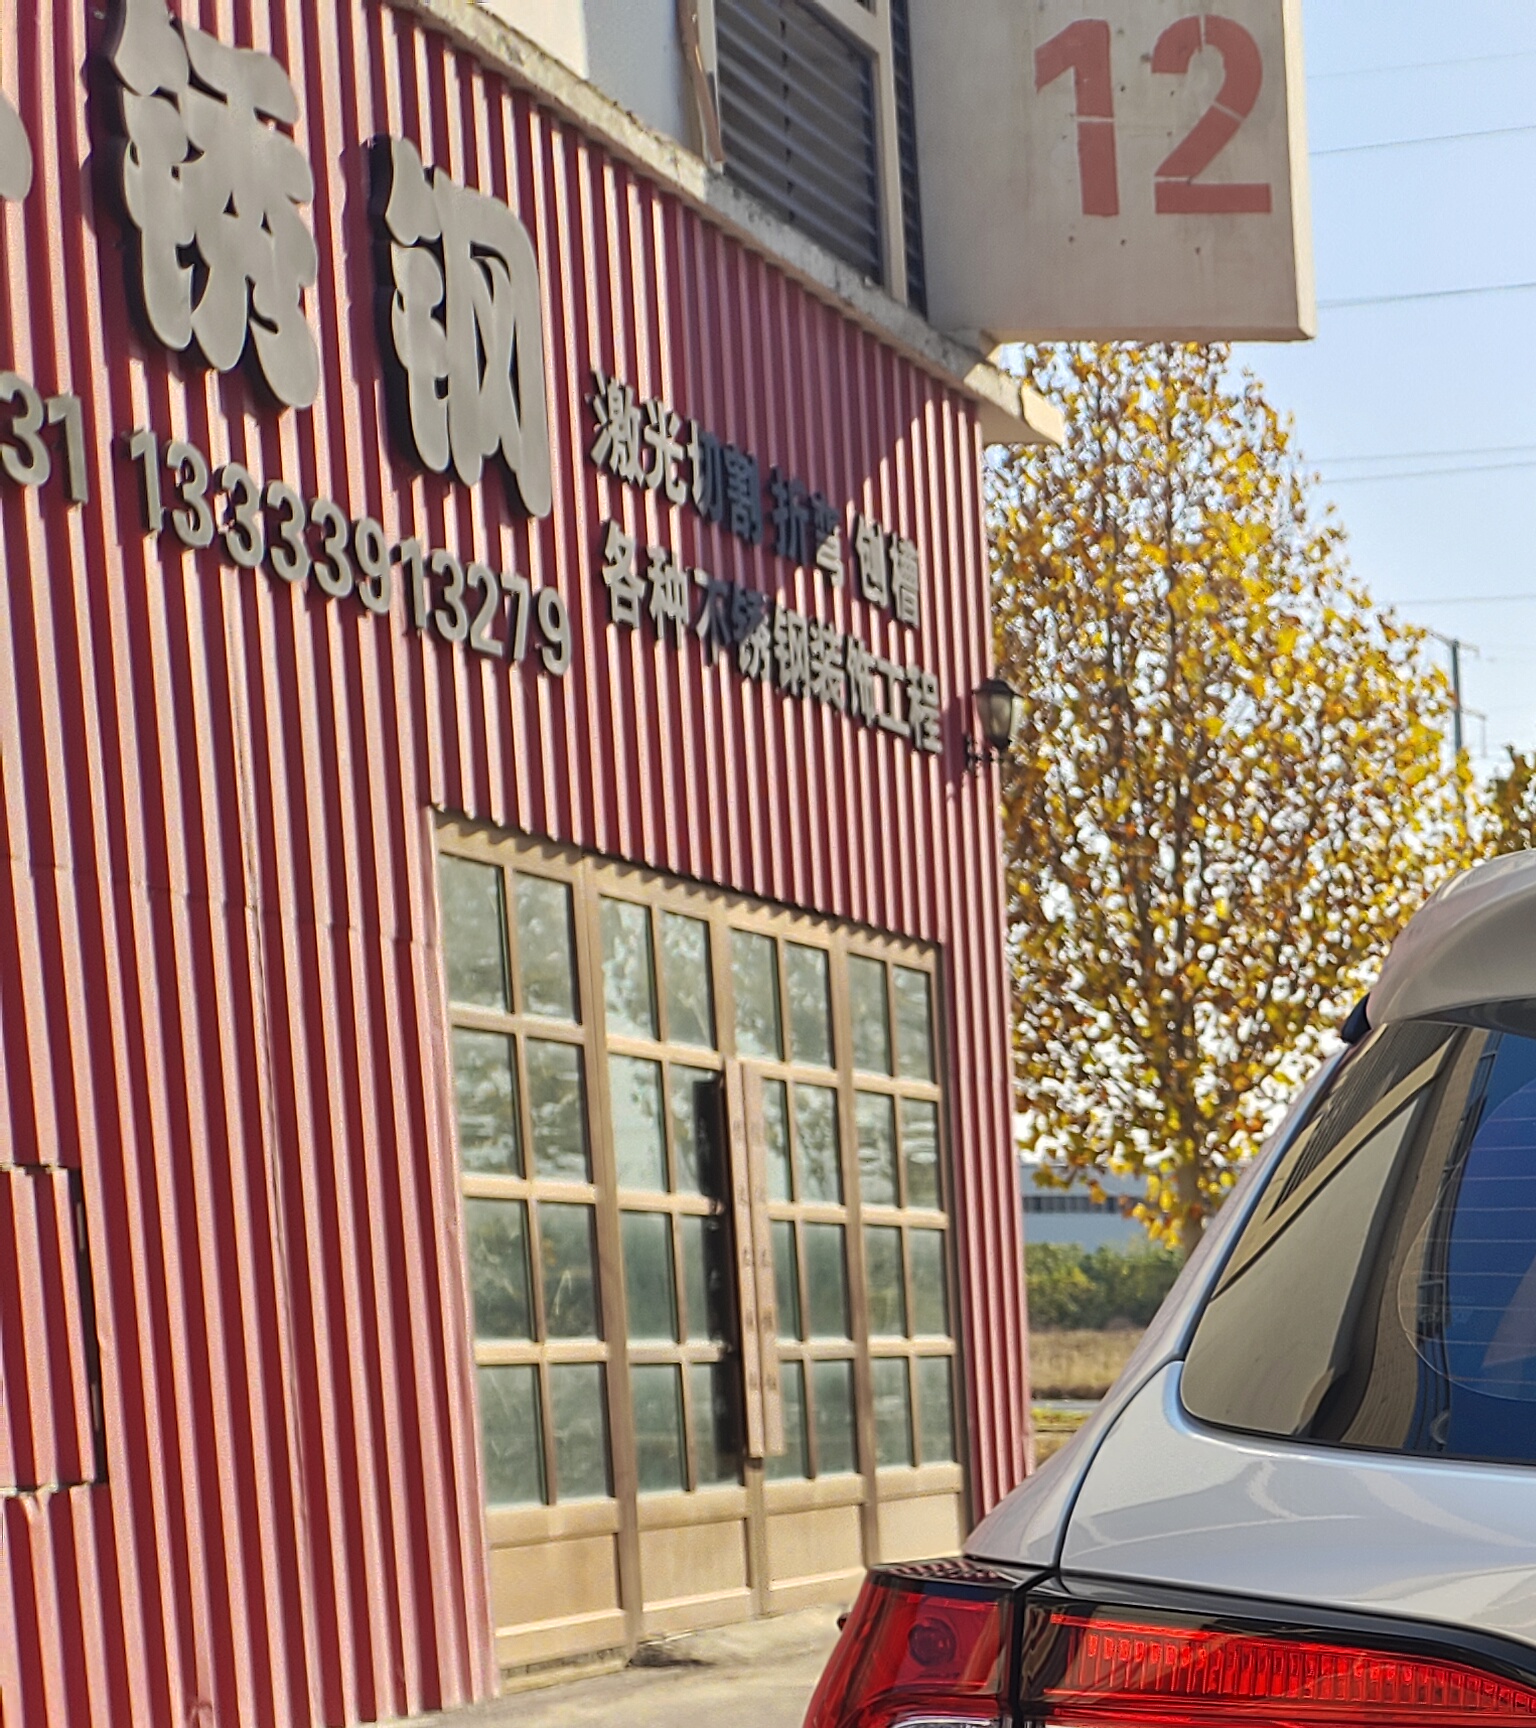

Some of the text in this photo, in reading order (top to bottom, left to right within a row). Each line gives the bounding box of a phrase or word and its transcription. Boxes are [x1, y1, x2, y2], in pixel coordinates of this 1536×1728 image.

[1035, 14, 1272, 217] 12
[130, 429, 571, 676] 13333913279
[602, 519, 943, 755] 各种不锈钢装饰工程
